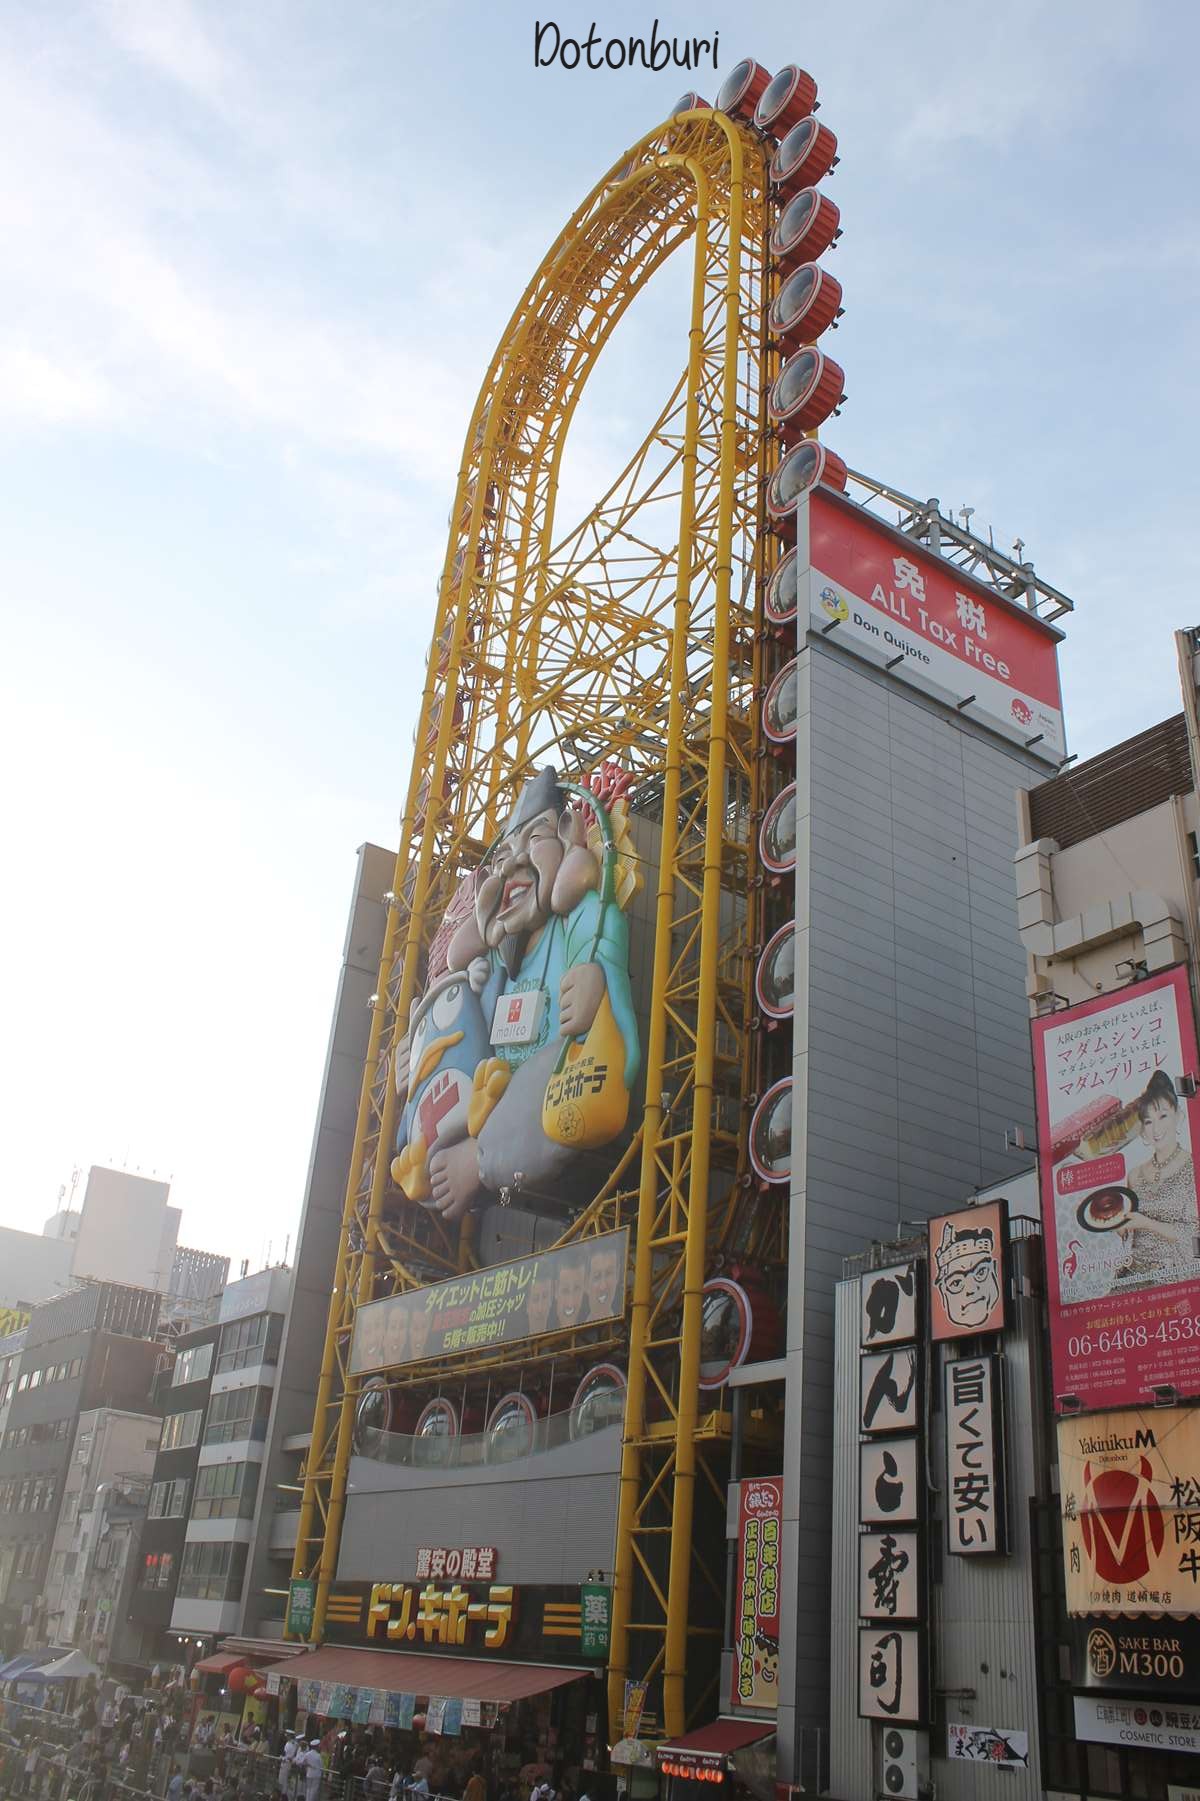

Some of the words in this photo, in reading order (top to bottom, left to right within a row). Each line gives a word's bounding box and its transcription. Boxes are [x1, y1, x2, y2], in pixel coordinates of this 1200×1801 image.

[853, 612, 880, 636] Don
[883, 630, 930, 665] Quijote
[870, 583, 911, 622] ALL
[918, 606, 958, 650] Tax
[965, 636, 1010, 680] Free
[1057, 1017, 1164, 1063] マダムシンコ
[951, 1361, 990, 1547] 旨くて安い
[1079, 1434, 1134, 1455] Yakiniku
[416, 1548, 496, 1578] 驚安の殿堂
[1119, 1637, 1150, 1650] SAKE
[1153, 1638, 1182, 1653] BAR
[1119, 1652, 1185, 1679] M300
[1119, 1729, 1164, 1745] COSMETIC
[1168, 1735, 1196, 1748] STORE
